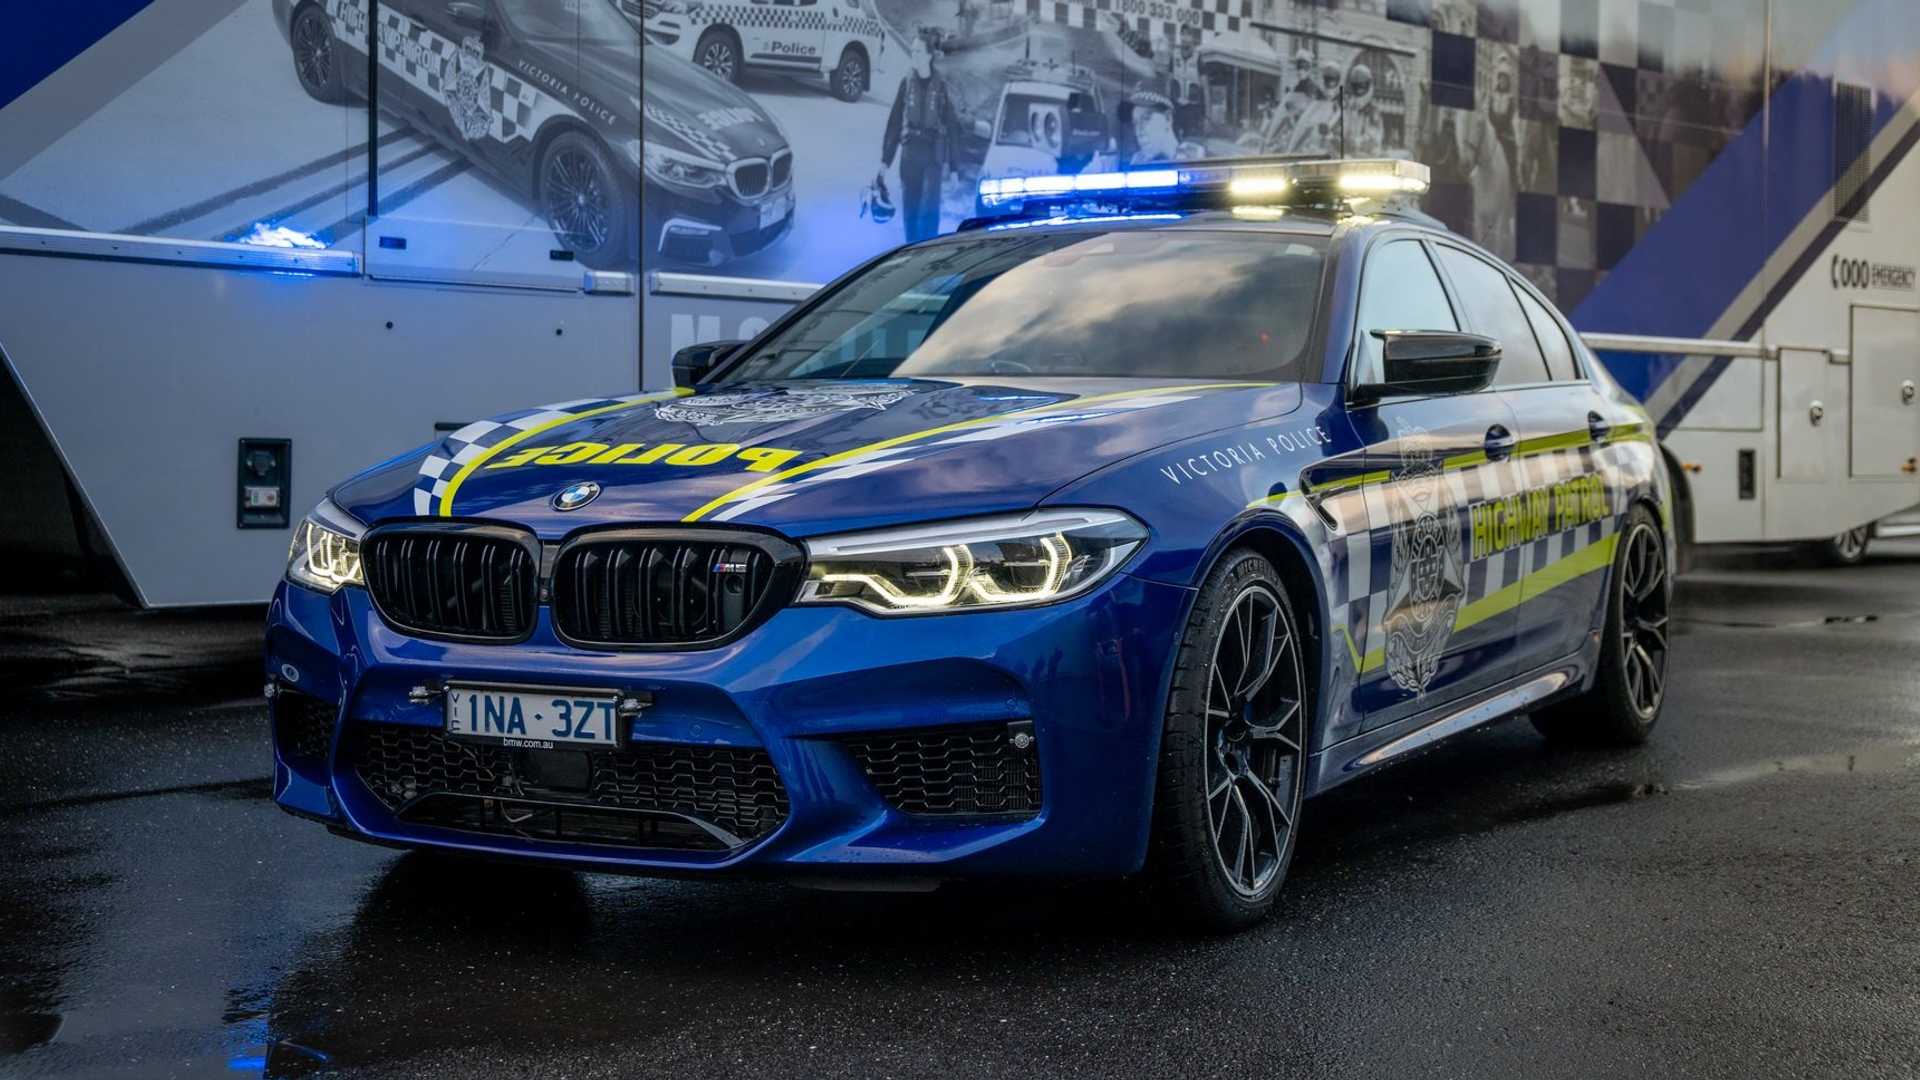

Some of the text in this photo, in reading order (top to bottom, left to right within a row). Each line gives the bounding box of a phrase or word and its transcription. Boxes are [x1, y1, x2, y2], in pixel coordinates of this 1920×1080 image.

[1149, 3, 1172, 20] 333
[1176, 8, 1199, 24] 000
[771, 41, 816, 55] Police
[519, 60, 617, 126] VICTORIA POLICE
[1841, 257, 1870, 289] 000
[1160, 426, 1332, 485] VICTORIA POLICE
[1472, 485, 1551, 560] HIGHWAY
[503, 737, 554, 749] bmw.com.au
